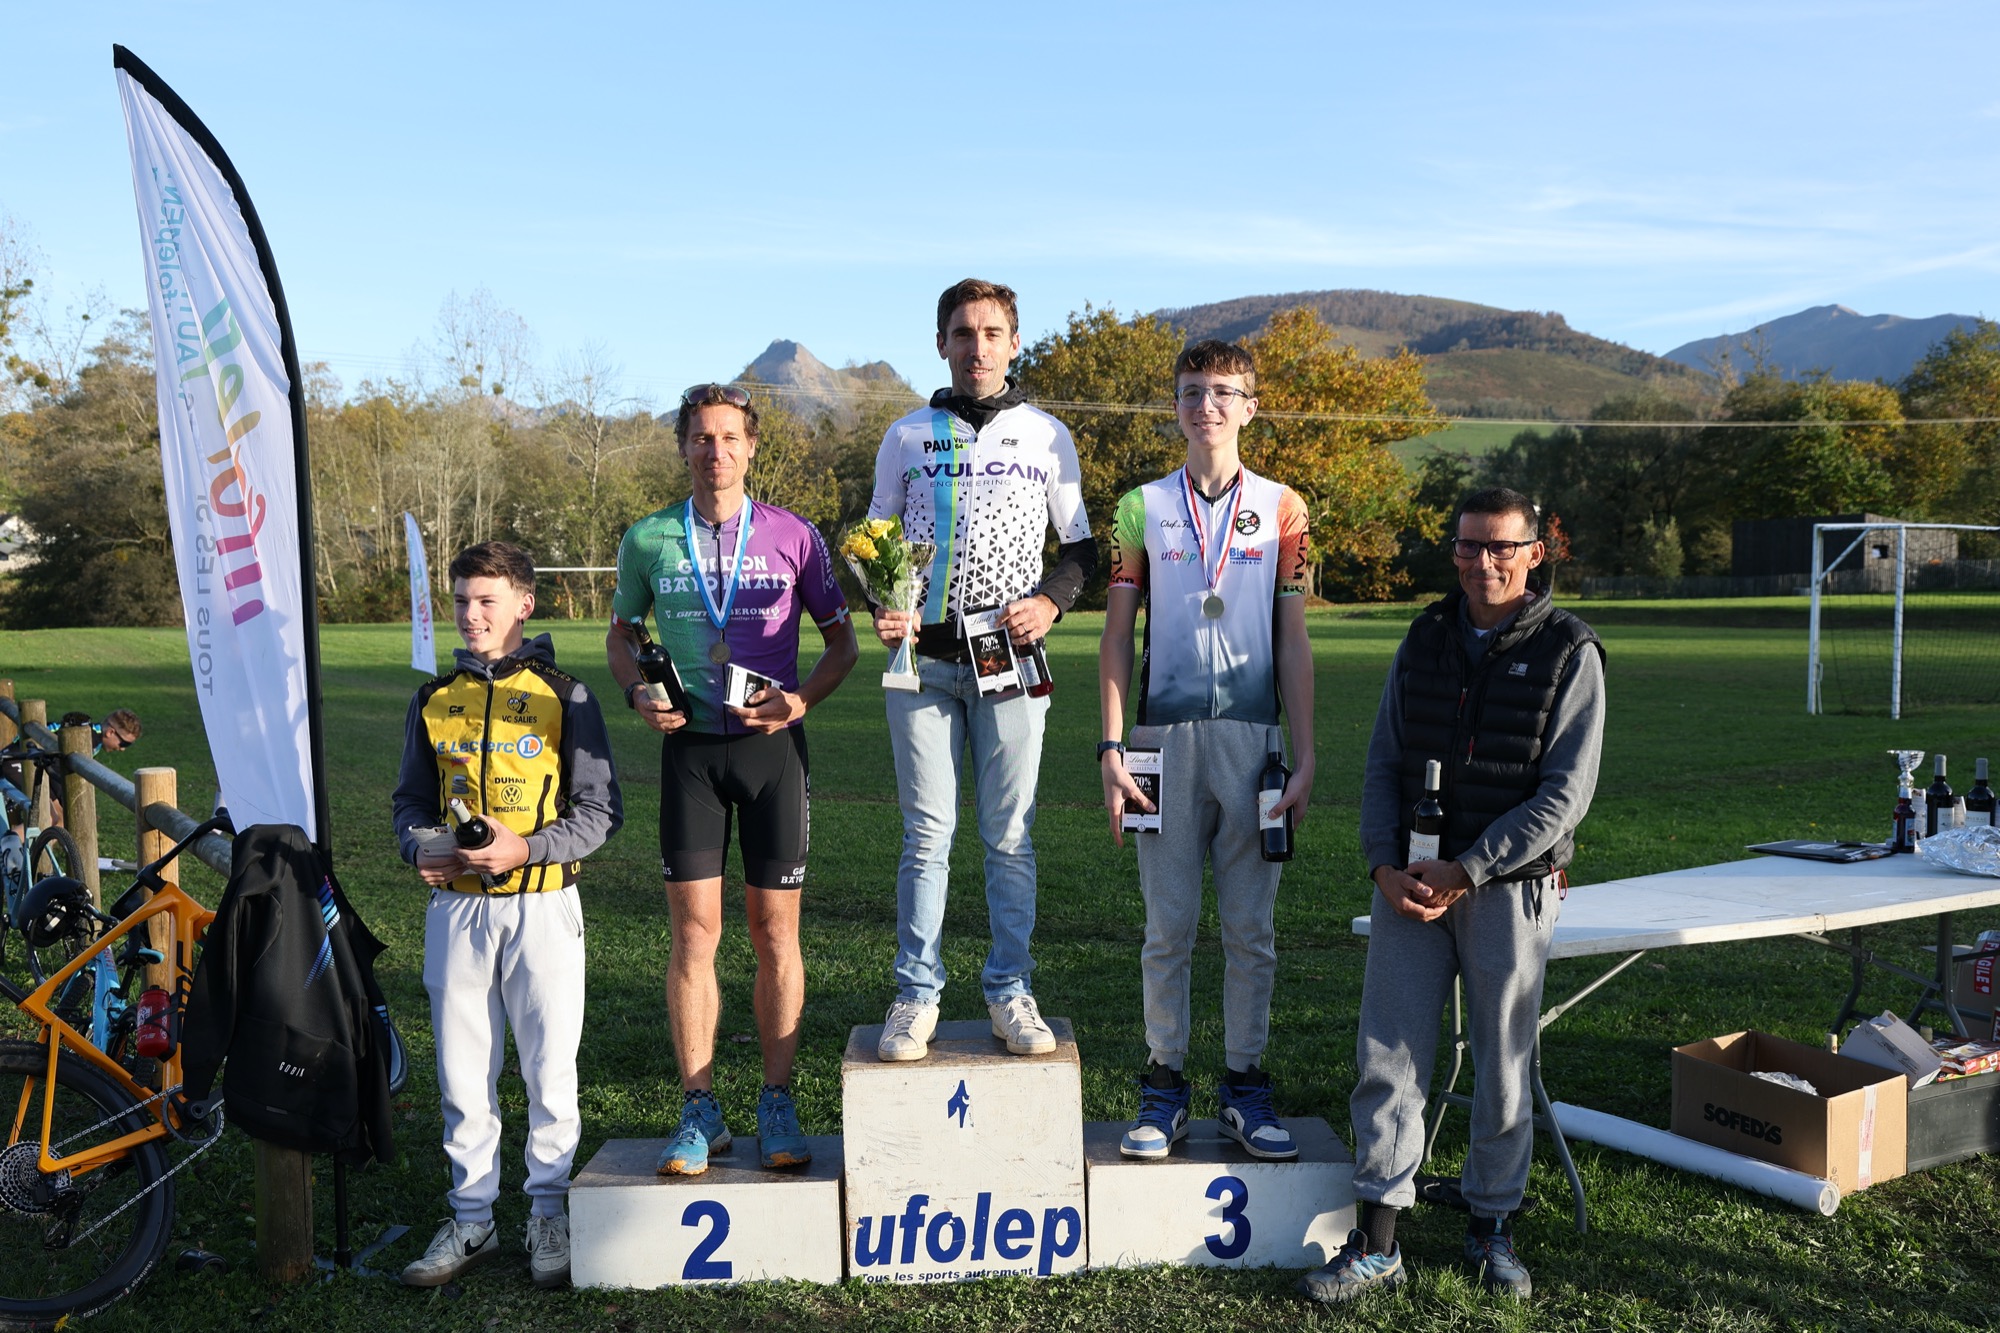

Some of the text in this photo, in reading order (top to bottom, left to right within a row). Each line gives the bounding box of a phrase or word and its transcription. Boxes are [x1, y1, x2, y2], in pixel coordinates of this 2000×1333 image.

[923, 439, 952, 454] PAU
[1001, 438, 1019, 446] CS
[922, 462, 1048, 485] VULCAIN
[929, 479, 1012, 488] ENGINEERING
[1160, 519, 1178, 529] Chef
[1161, 548, 1198, 566] ufolep
[1229, 547, 1264, 560] BigMat
[979, 634, 999, 649] 70%
[981, 644, 1000, 652] CACAO
[502, 715, 538, 724] VC SALIES
[1128, 754, 1152, 764] Lindt
[1134, 776, 1152, 786] 70%
[1977, 942, 1999, 985] FGILE
[1203, 1175, 1252, 1260] 3
[681, 1199, 733, 1280] 2
[854, 1191, 1082, 1277] ufolep
[894, 1271, 913, 1283] les
[918, 1270, 960, 1283] sports
[964, 1266, 1034, 1279] autrement
